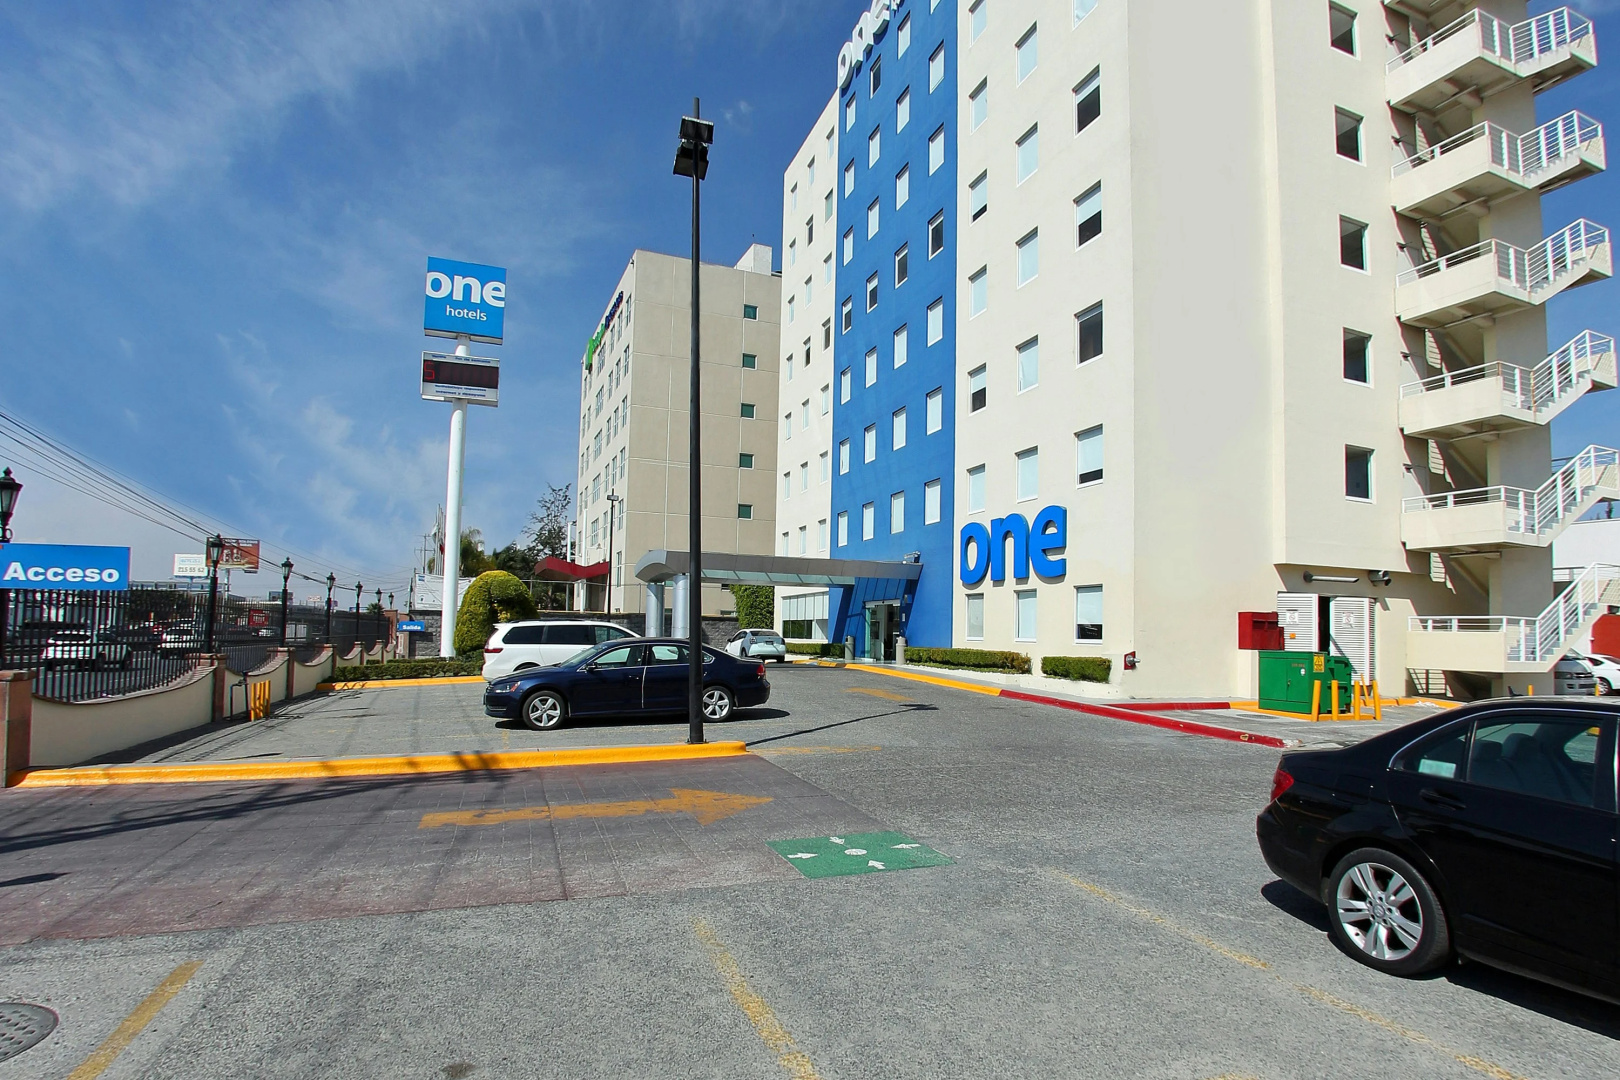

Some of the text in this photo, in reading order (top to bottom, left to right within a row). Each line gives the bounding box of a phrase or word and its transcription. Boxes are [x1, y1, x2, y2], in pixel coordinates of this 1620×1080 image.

[426, 271, 505, 308] one
[446, 305, 487, 321] hotels
[960, 505, 1067, 585] one
[3, 562, 119, 583] Acceso
